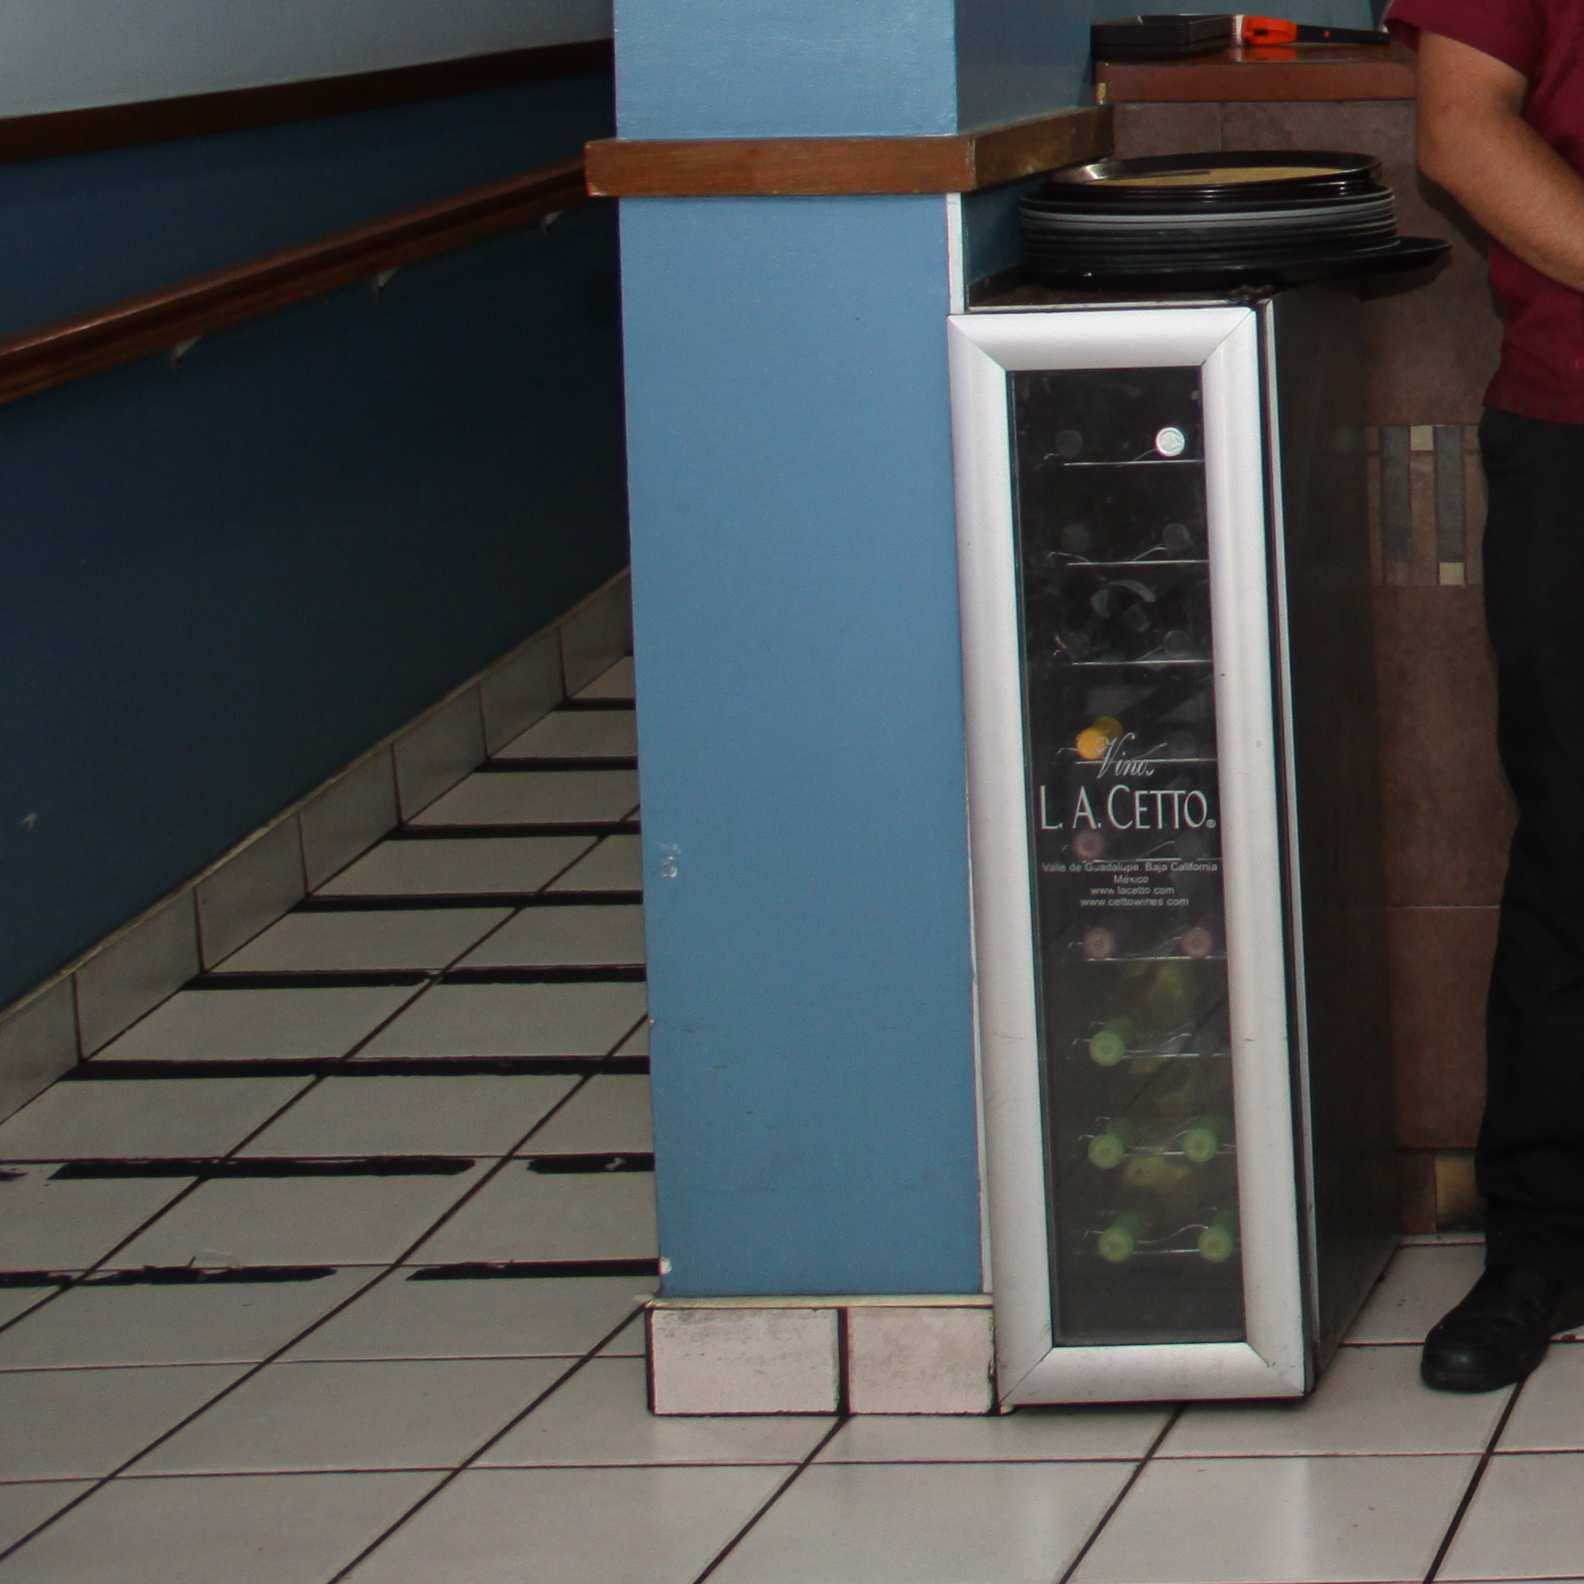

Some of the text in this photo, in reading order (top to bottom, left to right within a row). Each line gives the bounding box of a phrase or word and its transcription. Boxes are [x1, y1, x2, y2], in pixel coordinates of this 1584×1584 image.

[1106, 784, 1209, 831] CETTO
[1042, 862, 1067, 872] Valle
[1069, 862, 1082, 872] de
[1145, 862, 1168, 874] Baja
[1170, 862, 1218, 872] California
